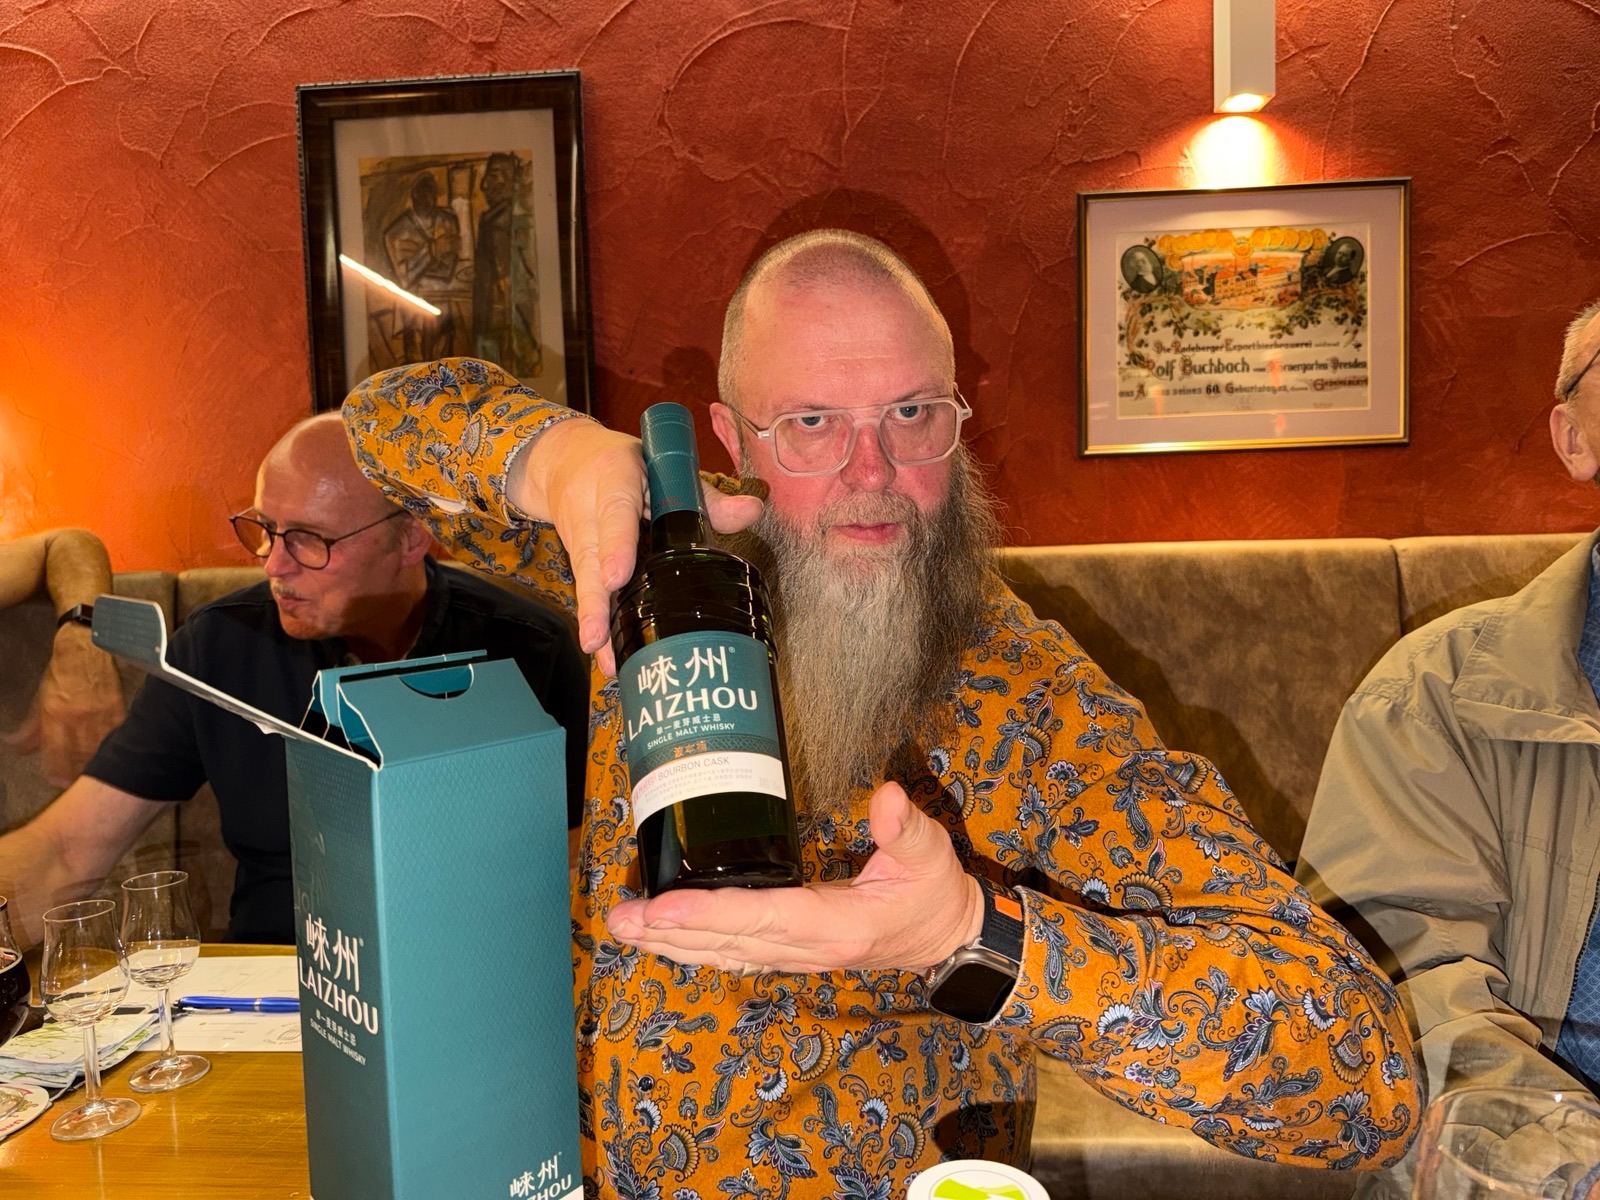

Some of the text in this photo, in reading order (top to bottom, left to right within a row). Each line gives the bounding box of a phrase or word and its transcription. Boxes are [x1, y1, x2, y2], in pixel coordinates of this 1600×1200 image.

[627, 686, 758, 742] LAIZHOU
[647, 731, 673, 750] SINGLE
[675, 726, 699, 737] MALT
[701, 722, 736, 732] WHISKY
[658, 756, 730, 781] BOURBON CASK
[298, 956, 379, 1035] LAIZHOU
[309, 1017, 328, 1040] SINGLE
[327, 1032, 342, 1050] MALT
[342, 1043, 367, 1066] WHISKY
